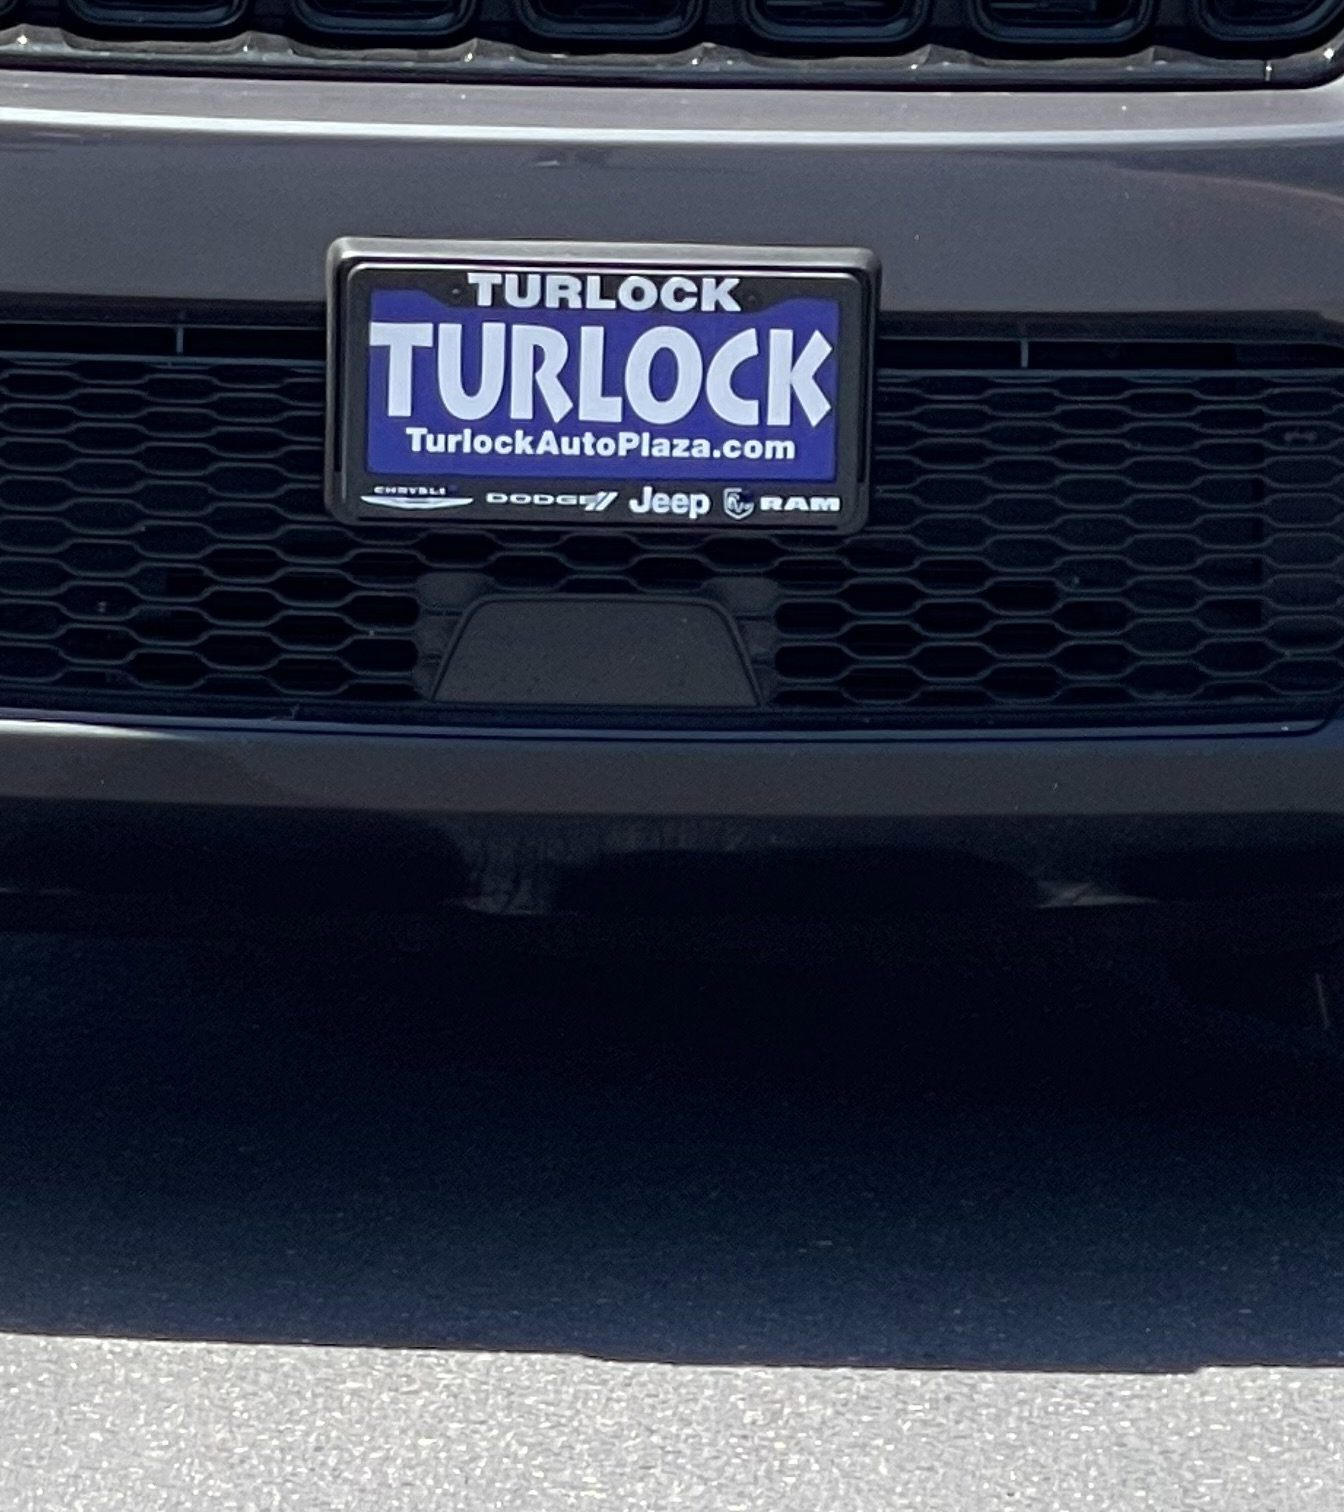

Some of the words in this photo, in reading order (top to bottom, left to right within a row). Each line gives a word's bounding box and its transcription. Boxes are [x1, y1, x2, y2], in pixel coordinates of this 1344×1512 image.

[467, 271, 742, 313] TURLOCK
[368, 321, 834, 429] TURLOCK
[405, 426, 796, 461] TurlockAutoPlaza.com
[628, 485, 712, 520] Jeep
[759, 496, 841, 512] RAM
